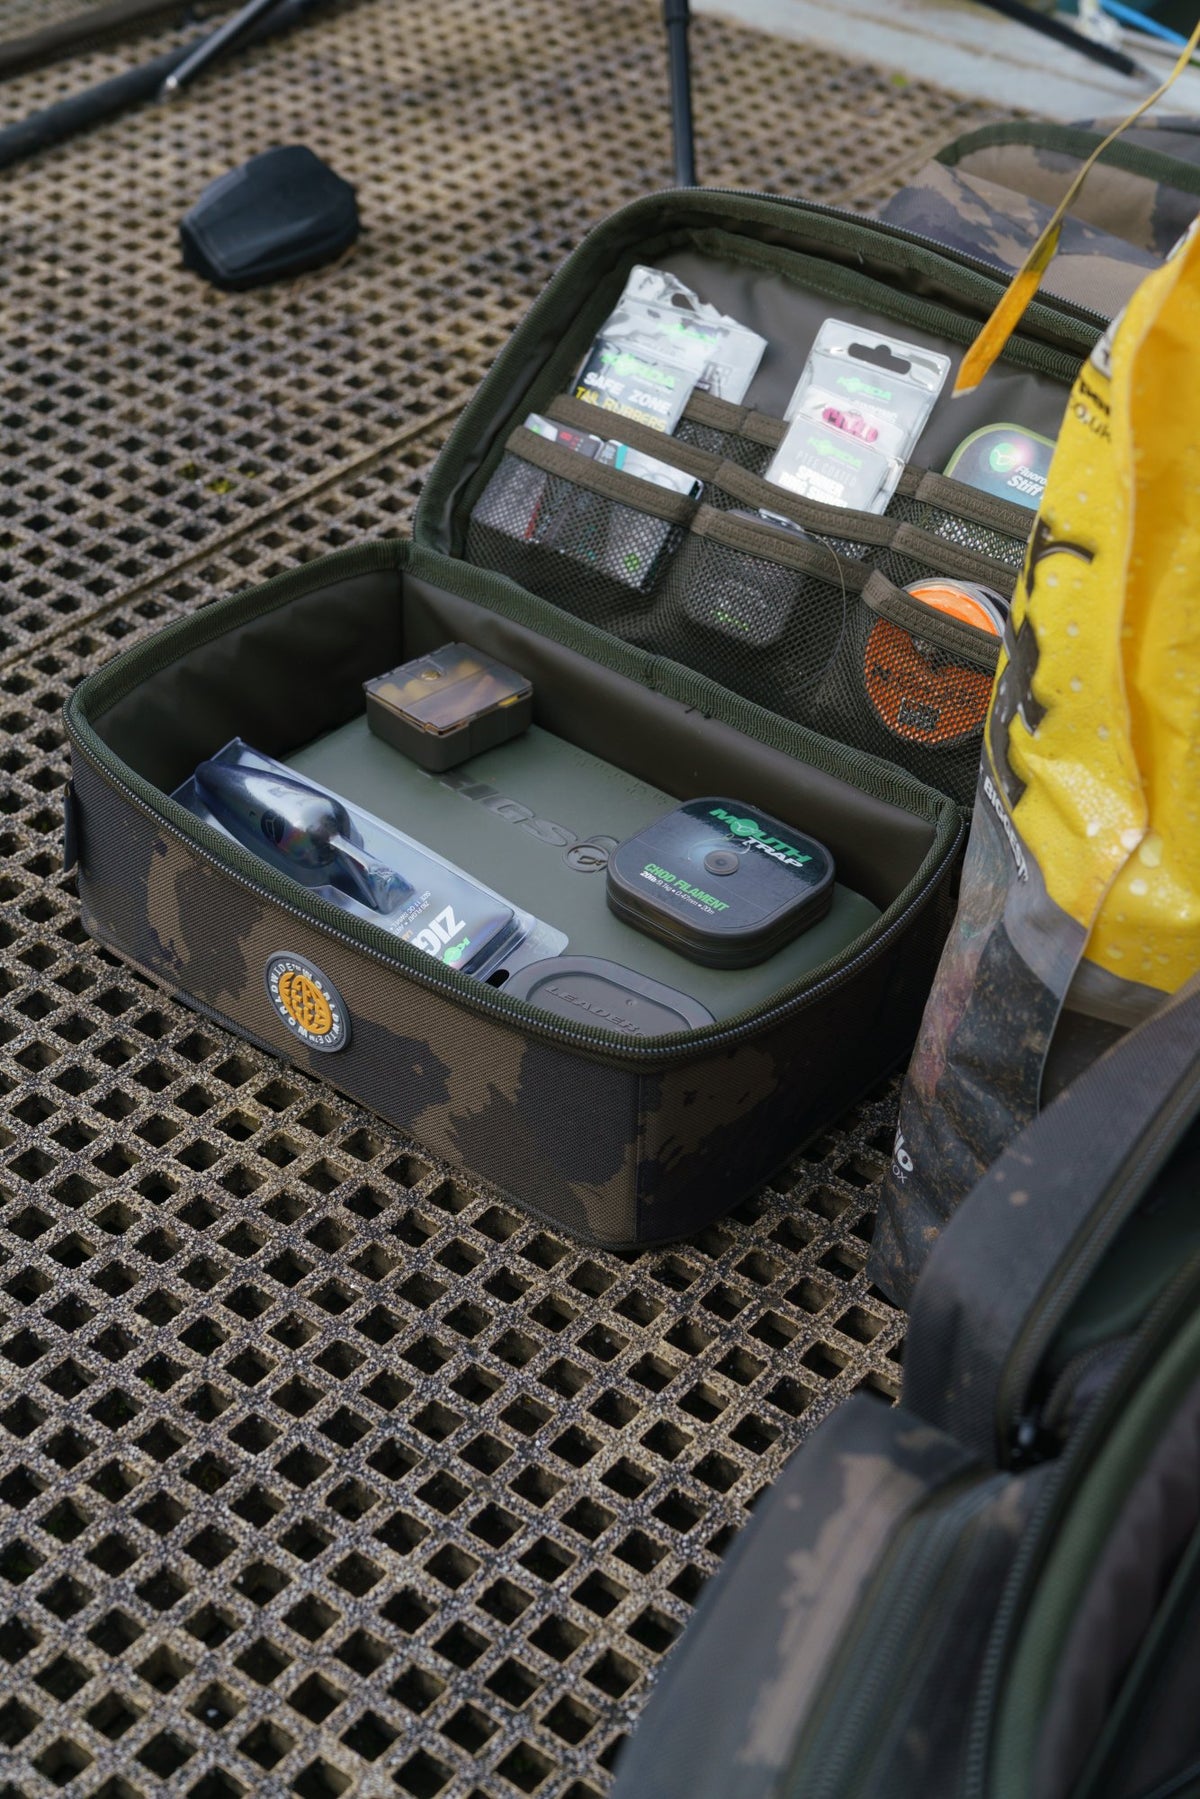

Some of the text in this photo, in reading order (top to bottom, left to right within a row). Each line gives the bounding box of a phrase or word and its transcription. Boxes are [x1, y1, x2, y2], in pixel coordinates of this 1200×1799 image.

[583, 372, 626, 395] SAFE
[628, 390, 672, 415] ZONE
[709, 808, 813, 863] MOUTH
[742, 836, 803, 868] TRAP
[643, 863, 730, 913] CHOD FILAMENT
[410, 904, 466, 957] ZIG
[544, 985, 648, 1037] LEADER
